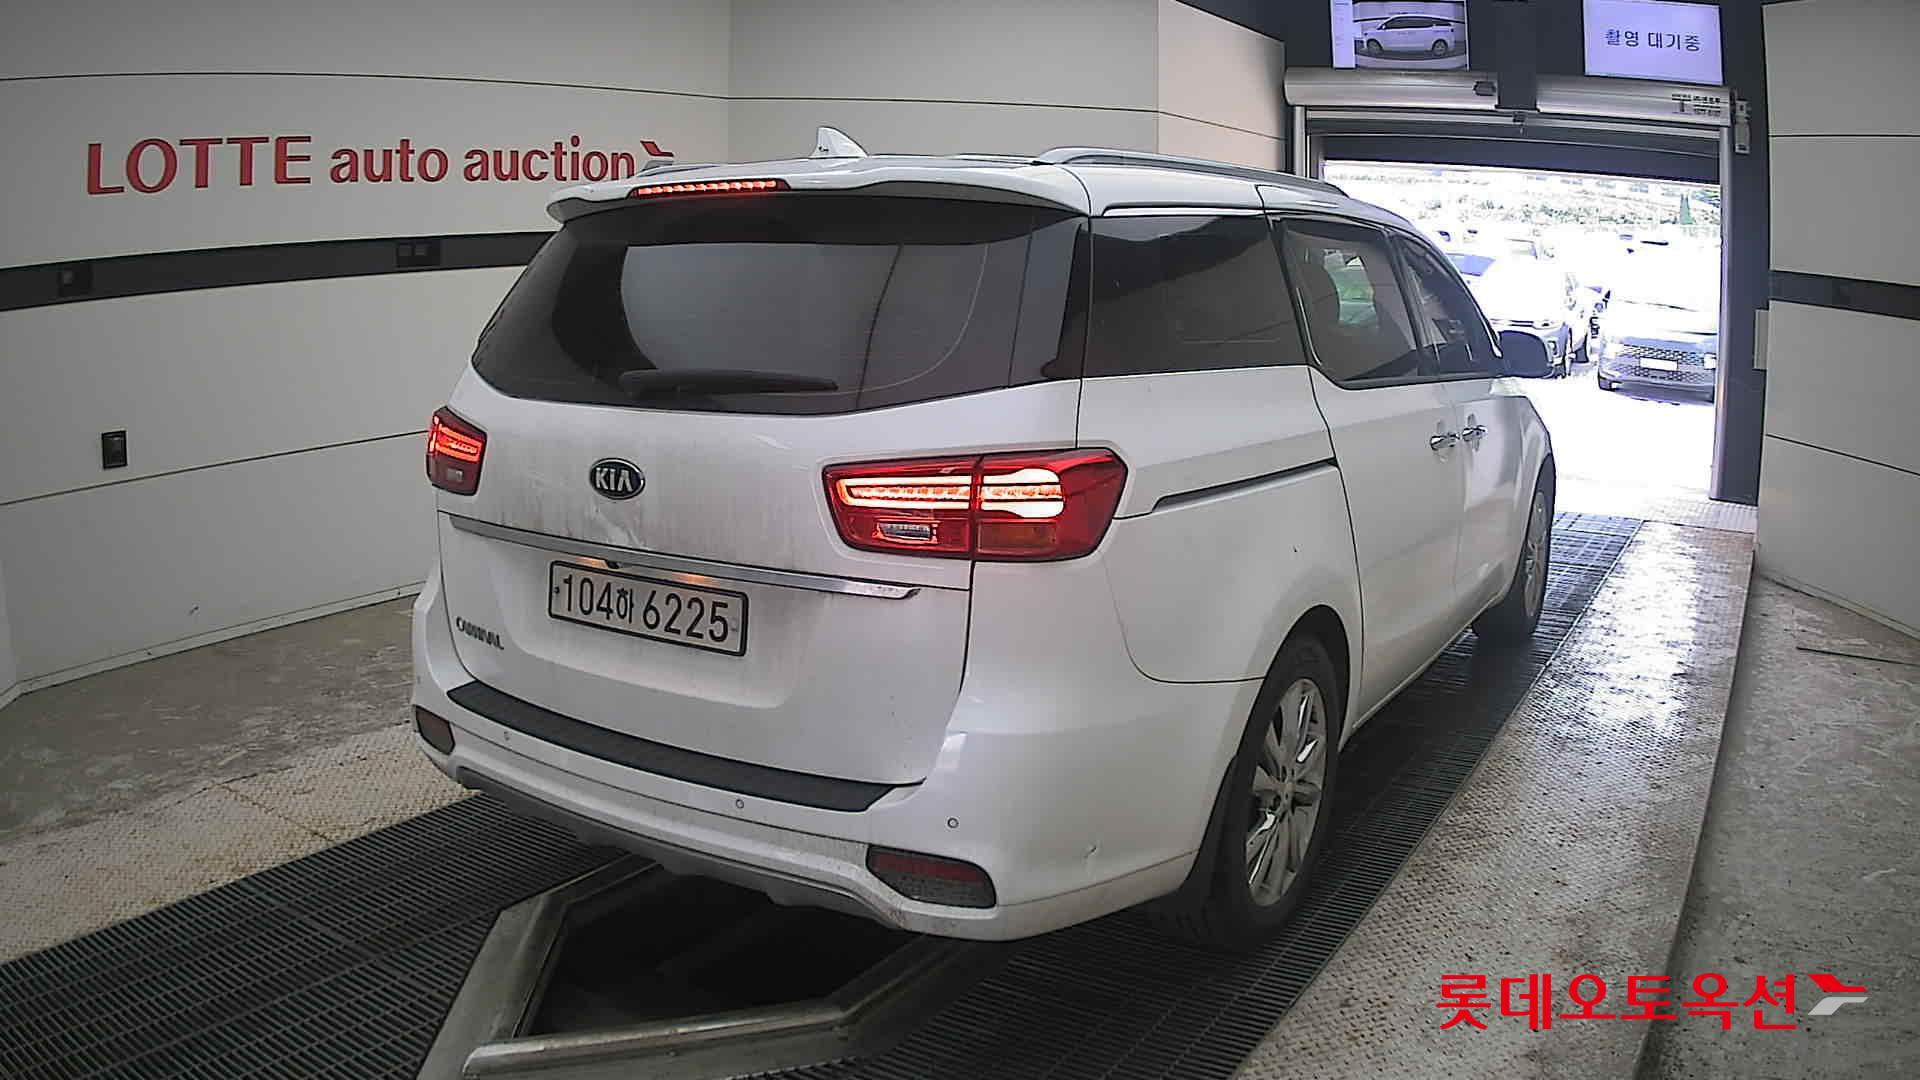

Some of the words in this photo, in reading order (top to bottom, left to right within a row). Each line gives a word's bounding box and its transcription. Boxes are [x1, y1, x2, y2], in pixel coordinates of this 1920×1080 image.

[1648, 32, 1701, 52] 대기중
[87, 136, 312, 195] LOTTE
[330, 138, 449, 183] auto
[463, 135, 635, 182] auction
[596, 467, 633, 491] KIA
[563, 574, 635, 625] 104하
[643, 590, 729, 643] 6225
